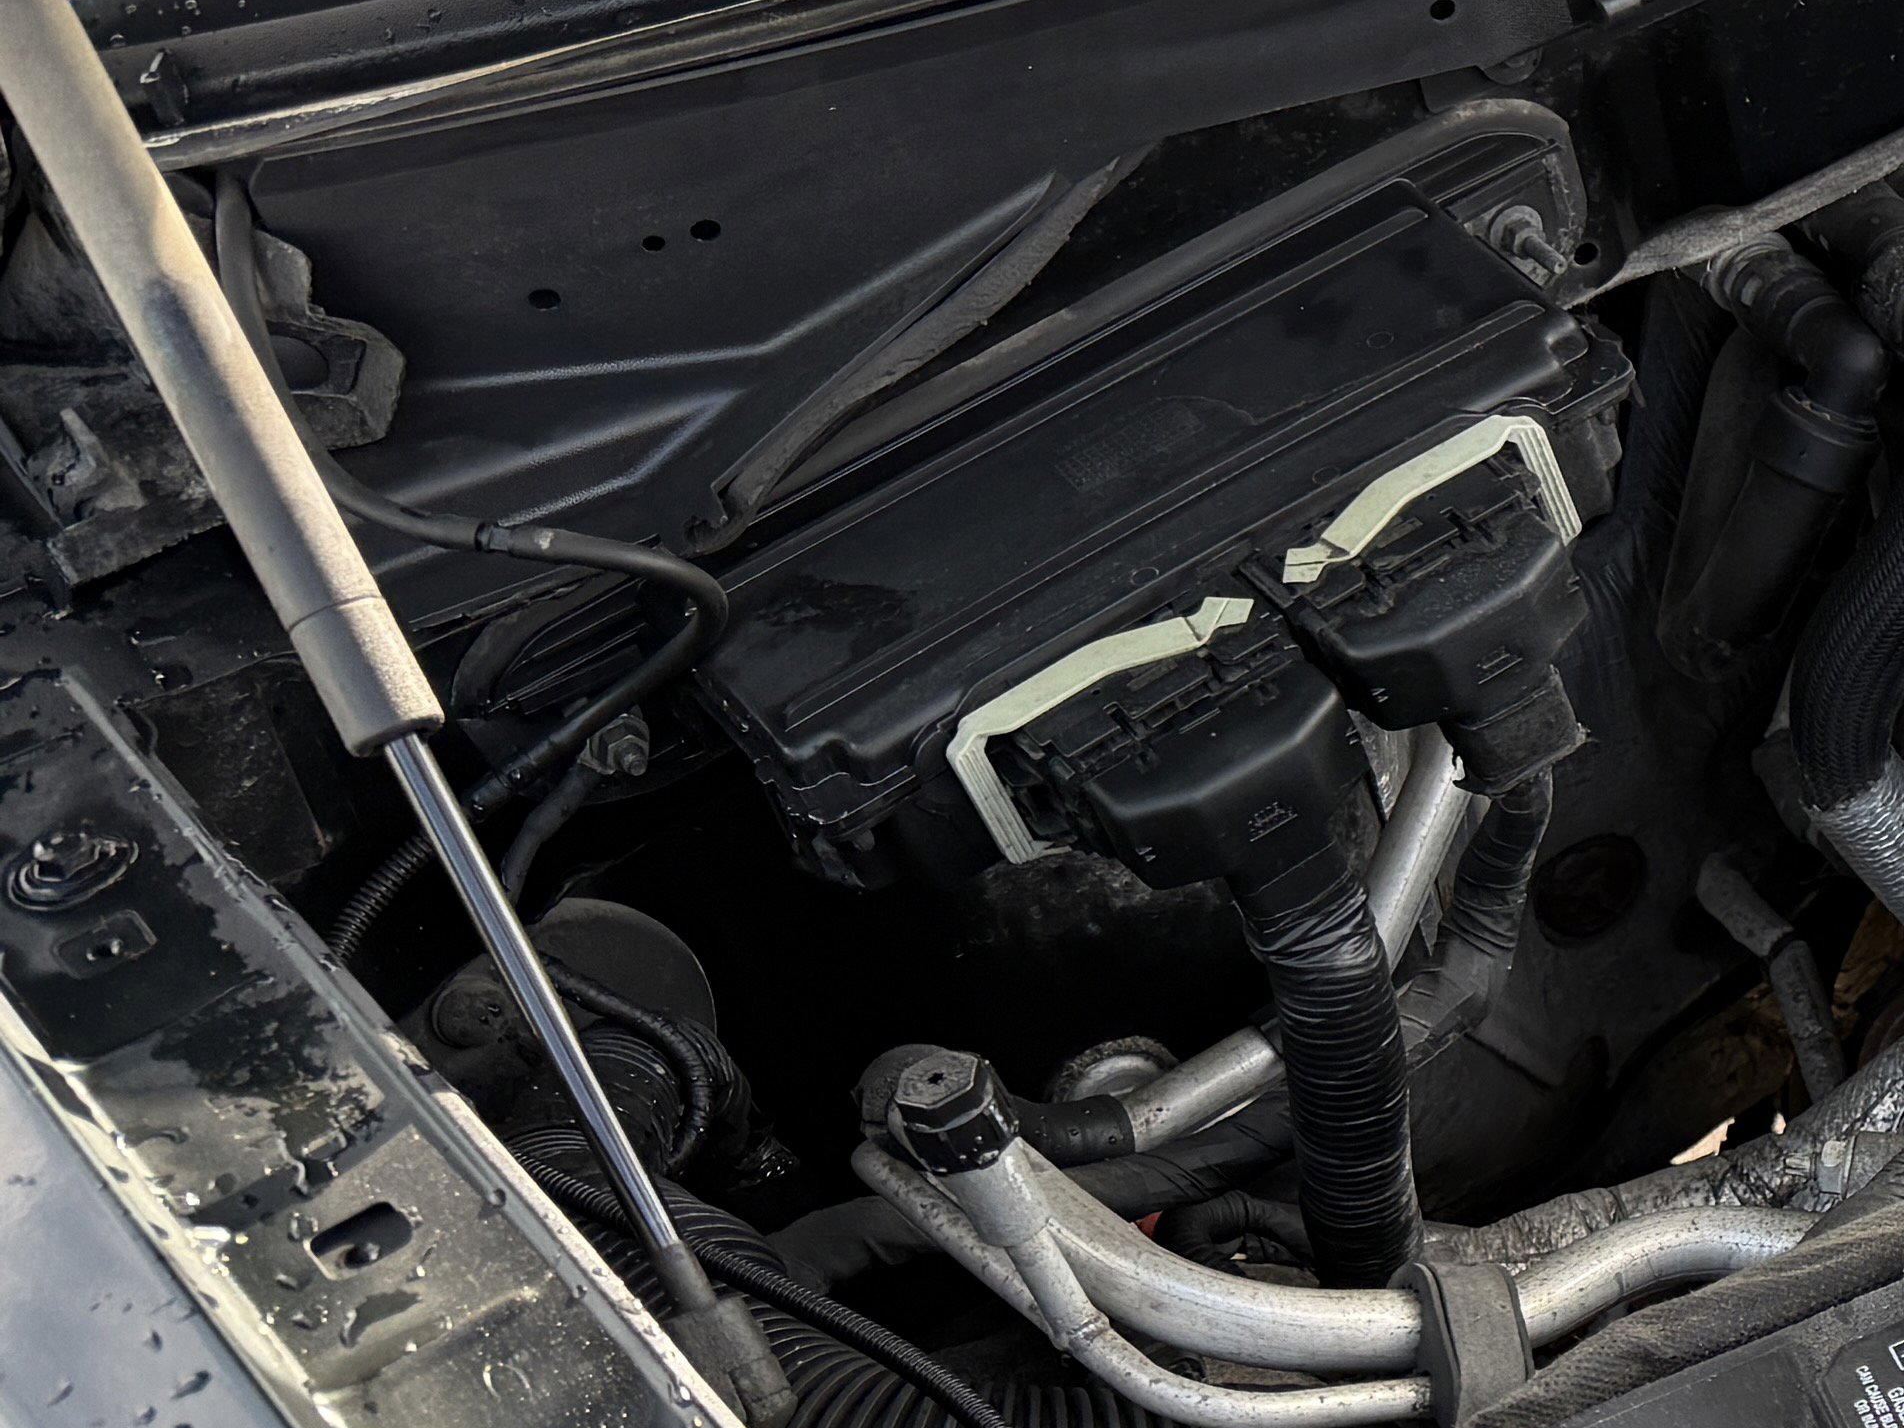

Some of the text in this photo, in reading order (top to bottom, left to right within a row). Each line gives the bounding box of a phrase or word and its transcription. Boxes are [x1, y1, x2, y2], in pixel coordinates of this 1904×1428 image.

[1856, 1365, 1874, 1385] CAN
[1865, 1385, 1889, 1415] CAUSE
[1854, 1399, 1870, 1414] OR
